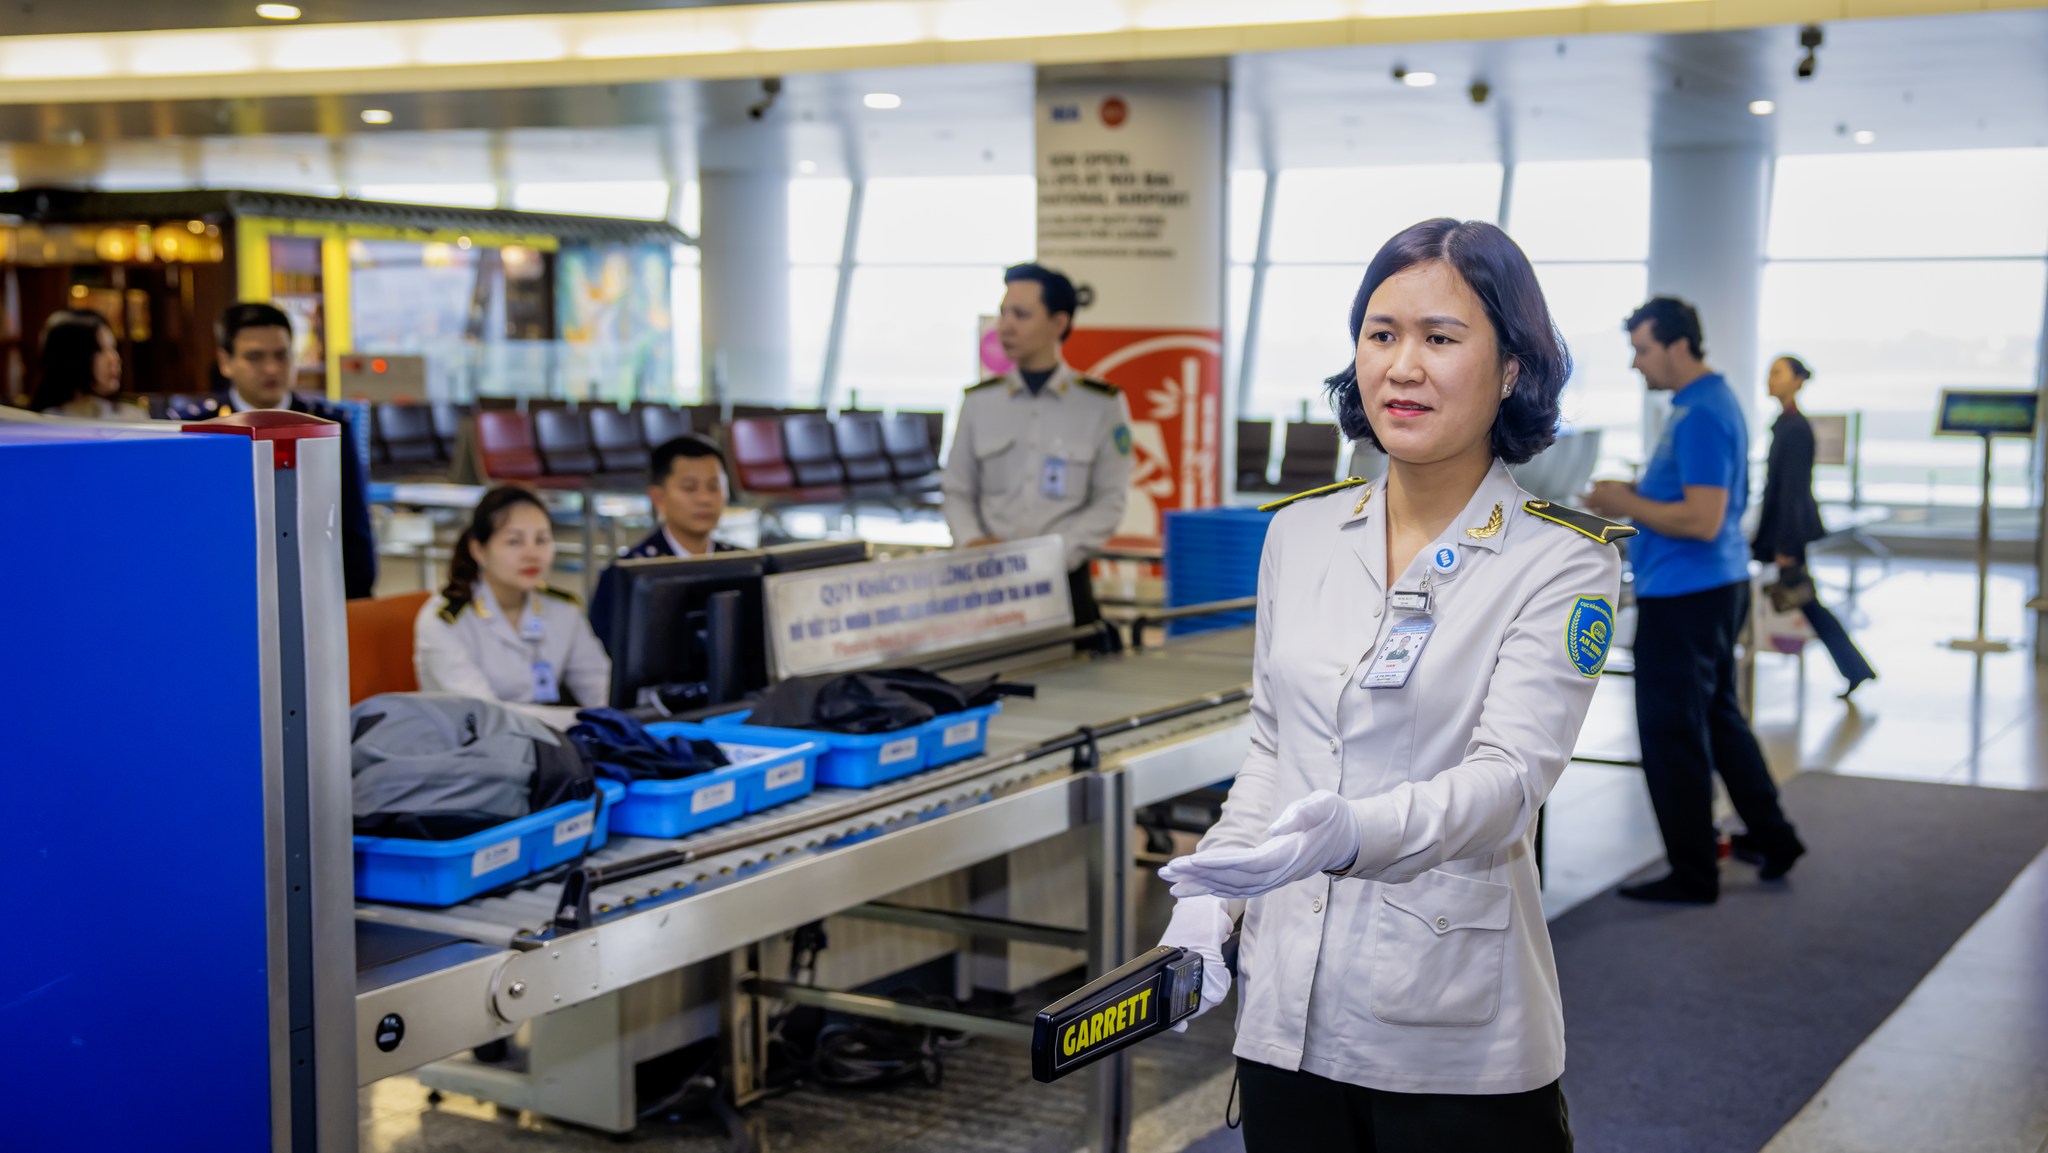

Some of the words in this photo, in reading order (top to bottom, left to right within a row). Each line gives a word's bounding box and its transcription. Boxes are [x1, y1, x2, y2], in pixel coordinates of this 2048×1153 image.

[1116, 192, 1190, 207] AIRPORT
[1439, 550, 1451, 566] NIA
[1579, 635, 1591, 647] AN
[1590, 642, 1602, 657] NINH
[1580, 646, 1597, 660] SECURITY
[1063, 988, 1153, 1056] GARRETT
